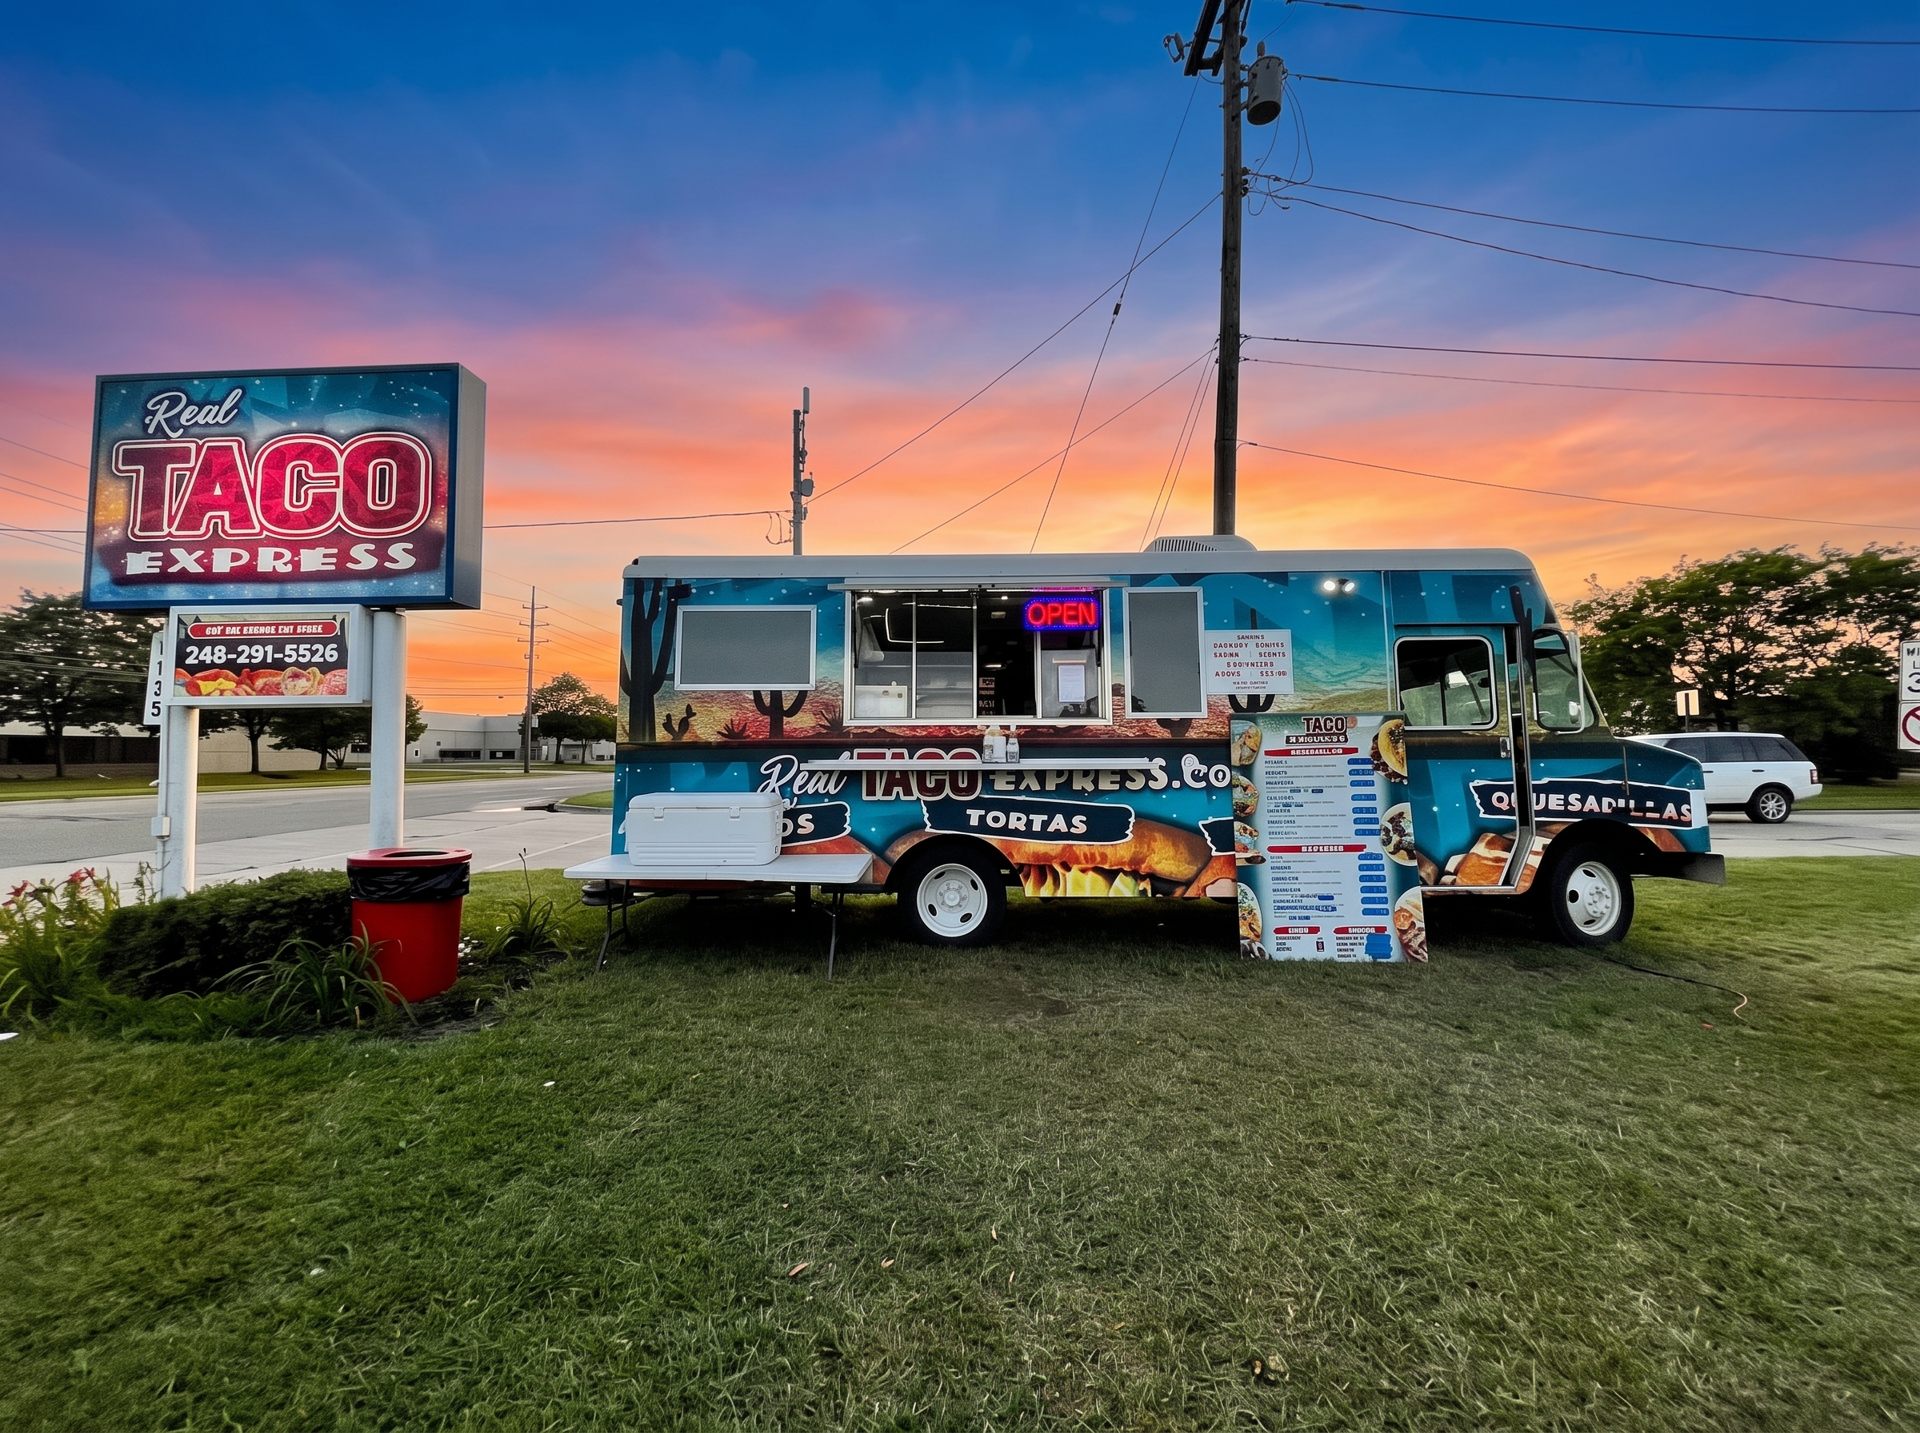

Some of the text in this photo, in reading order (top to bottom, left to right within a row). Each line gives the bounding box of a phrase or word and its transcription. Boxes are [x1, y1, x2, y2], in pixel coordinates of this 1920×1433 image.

[144, 388, 243, 439] Real
[112, 432, 433, 541] TACO
[124, 542, 417, 575] EXPRESS
[1027, 601, 1097, 627] OPEN
[185, 643, 339, 665] 248-291-5526
[1302, 715, 1346, 734] TACO
[757, 751, 851, 803] Real
[853, 747, 983, 801] TACO
[965, 808, 1088, 835] TORTAS
